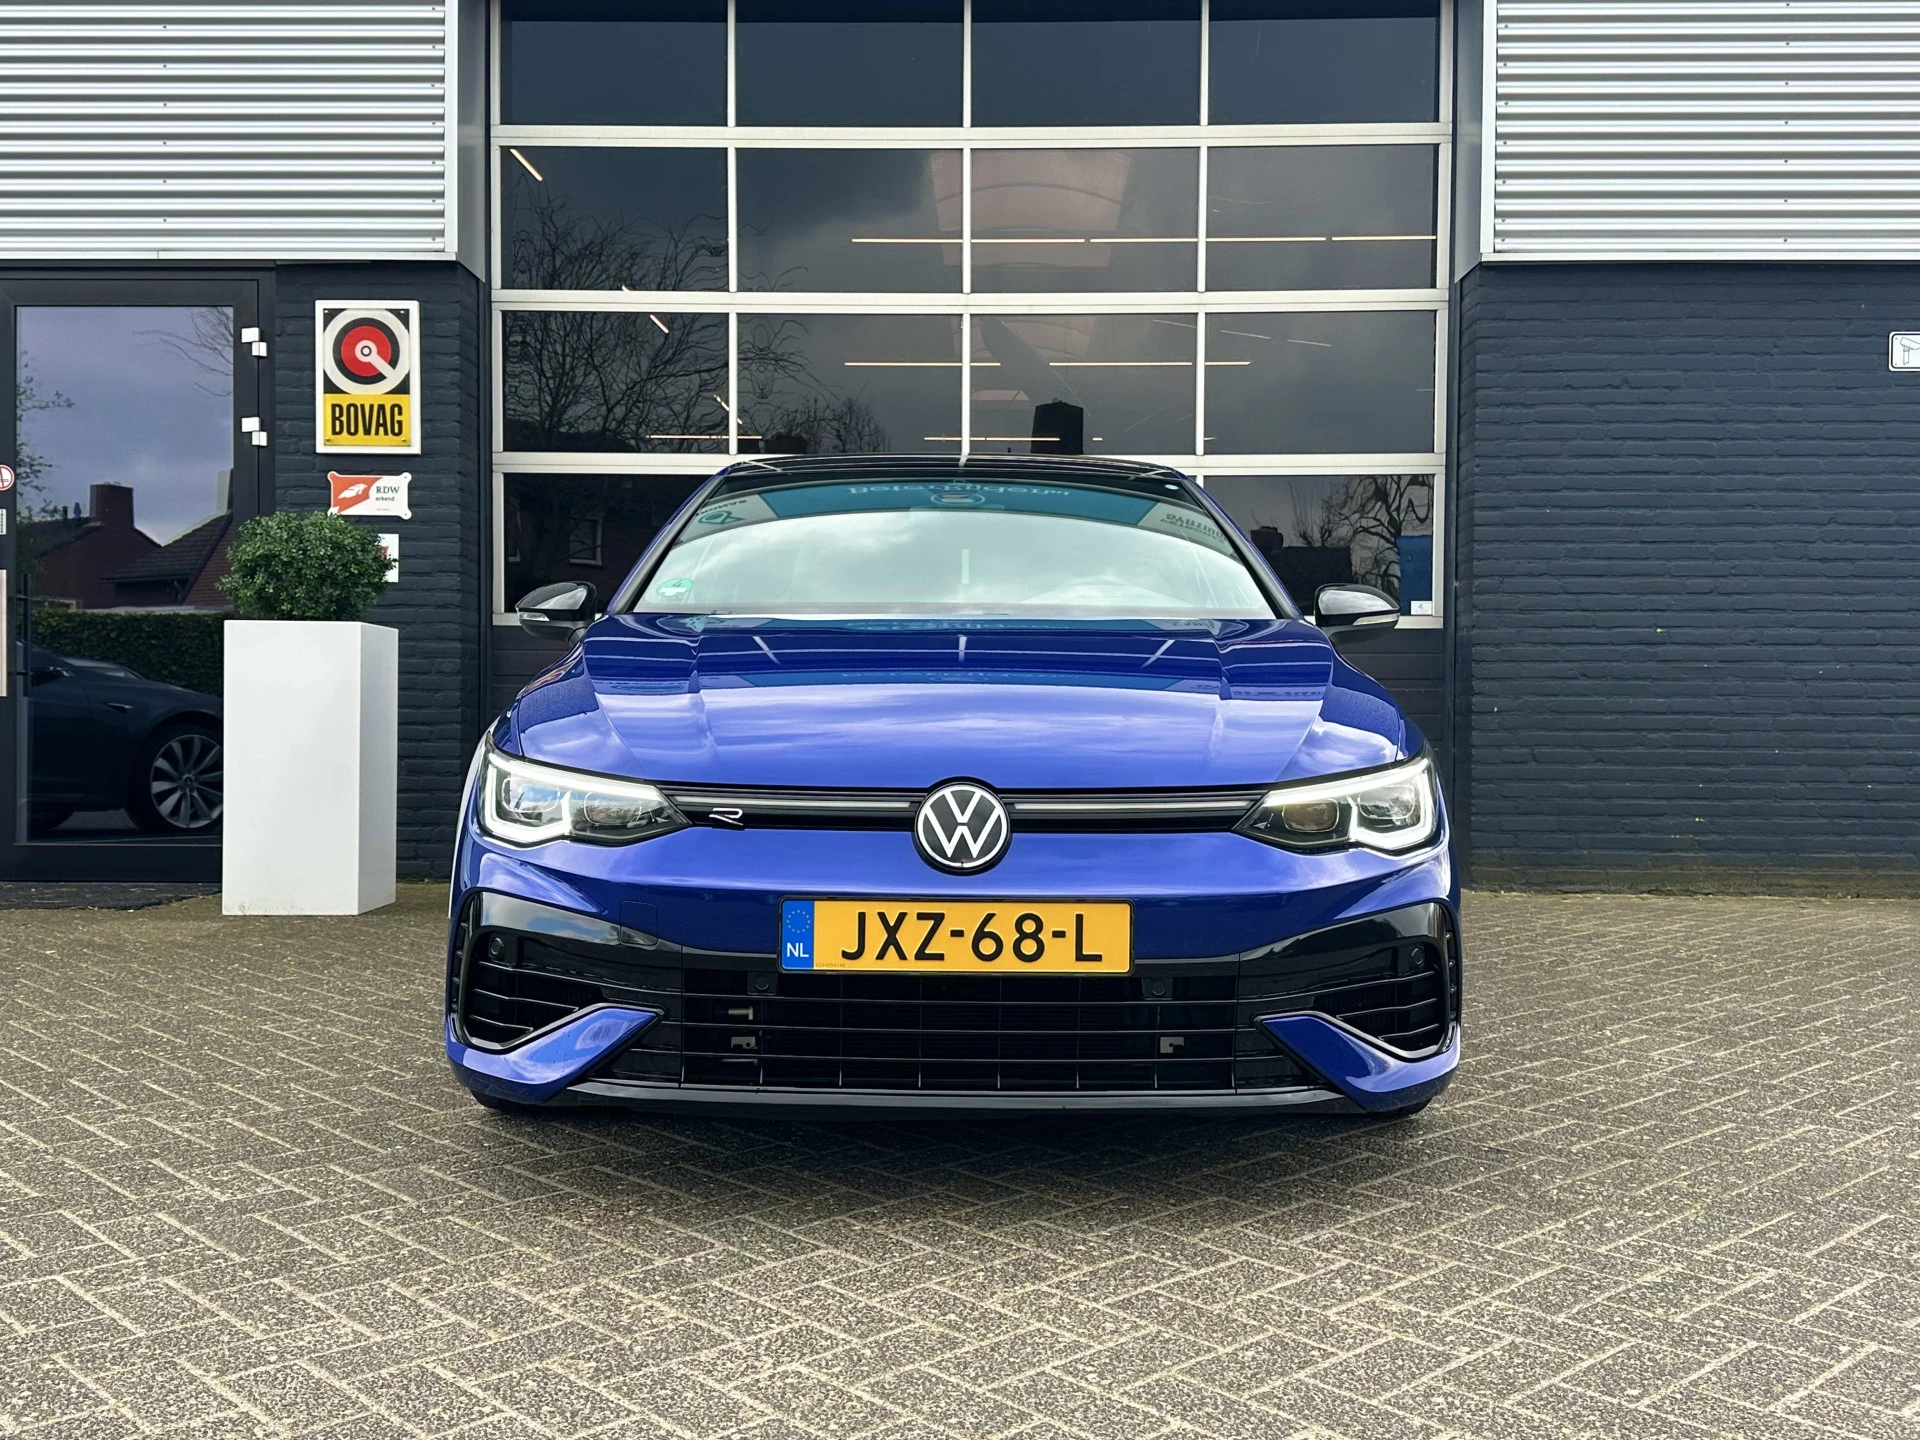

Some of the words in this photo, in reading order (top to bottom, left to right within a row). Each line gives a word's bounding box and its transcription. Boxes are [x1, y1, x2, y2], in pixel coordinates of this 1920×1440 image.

[331, 402, 403, 437] BOVAG
[376, 486, 400, 494] RDW
[841, 911, 1103, 963] JXZ-68-L
[786, 942, 809, 958] NL
